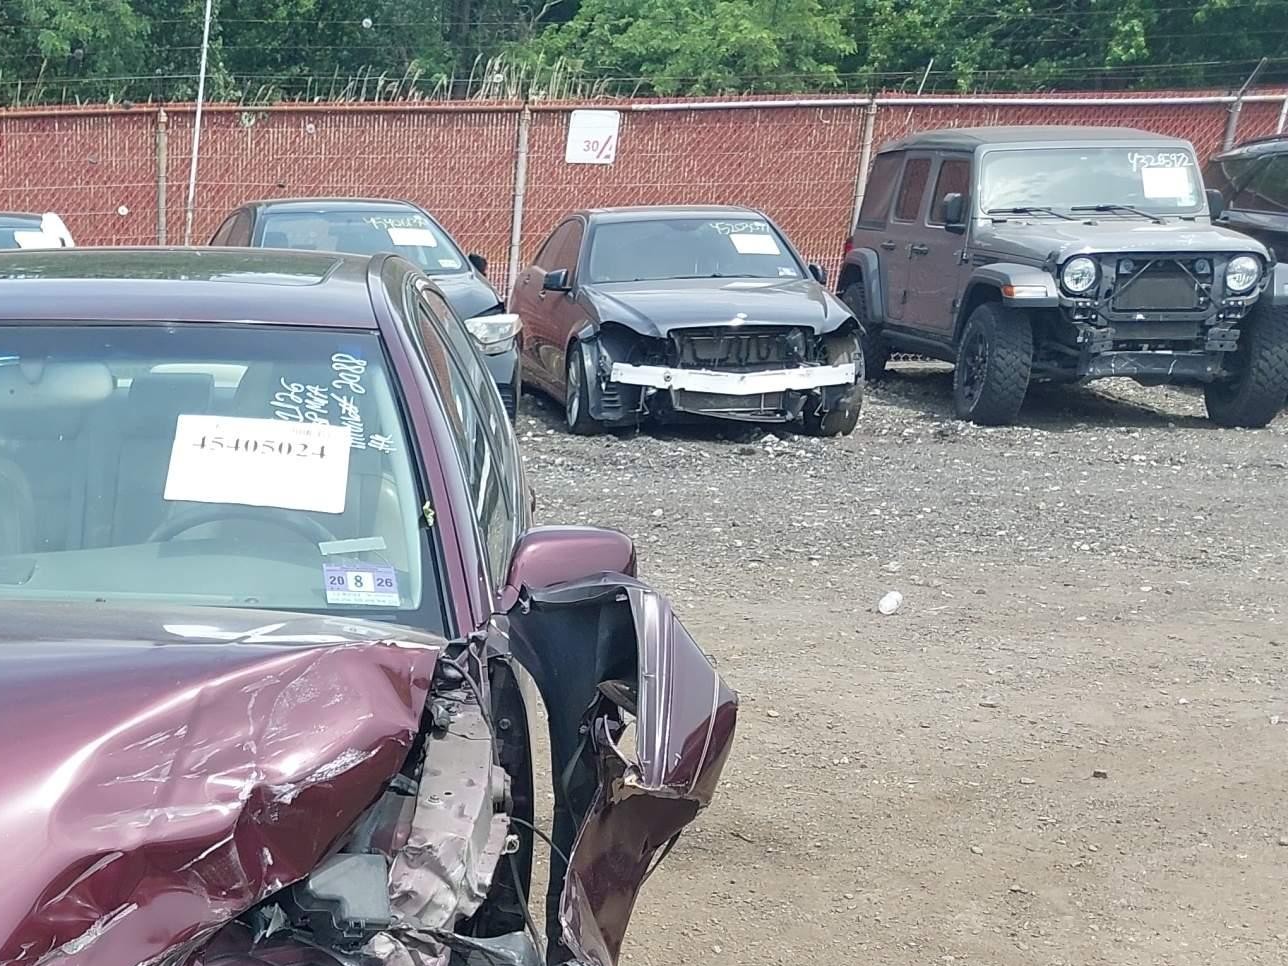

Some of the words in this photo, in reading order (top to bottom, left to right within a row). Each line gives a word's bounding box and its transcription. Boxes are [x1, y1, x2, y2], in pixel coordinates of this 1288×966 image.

[192, 434, 326, 459] 45405024
[329, 575, 345, 586] 20
[354, 574, 364, 588] 8
[376, 577, 393, 588] 26
